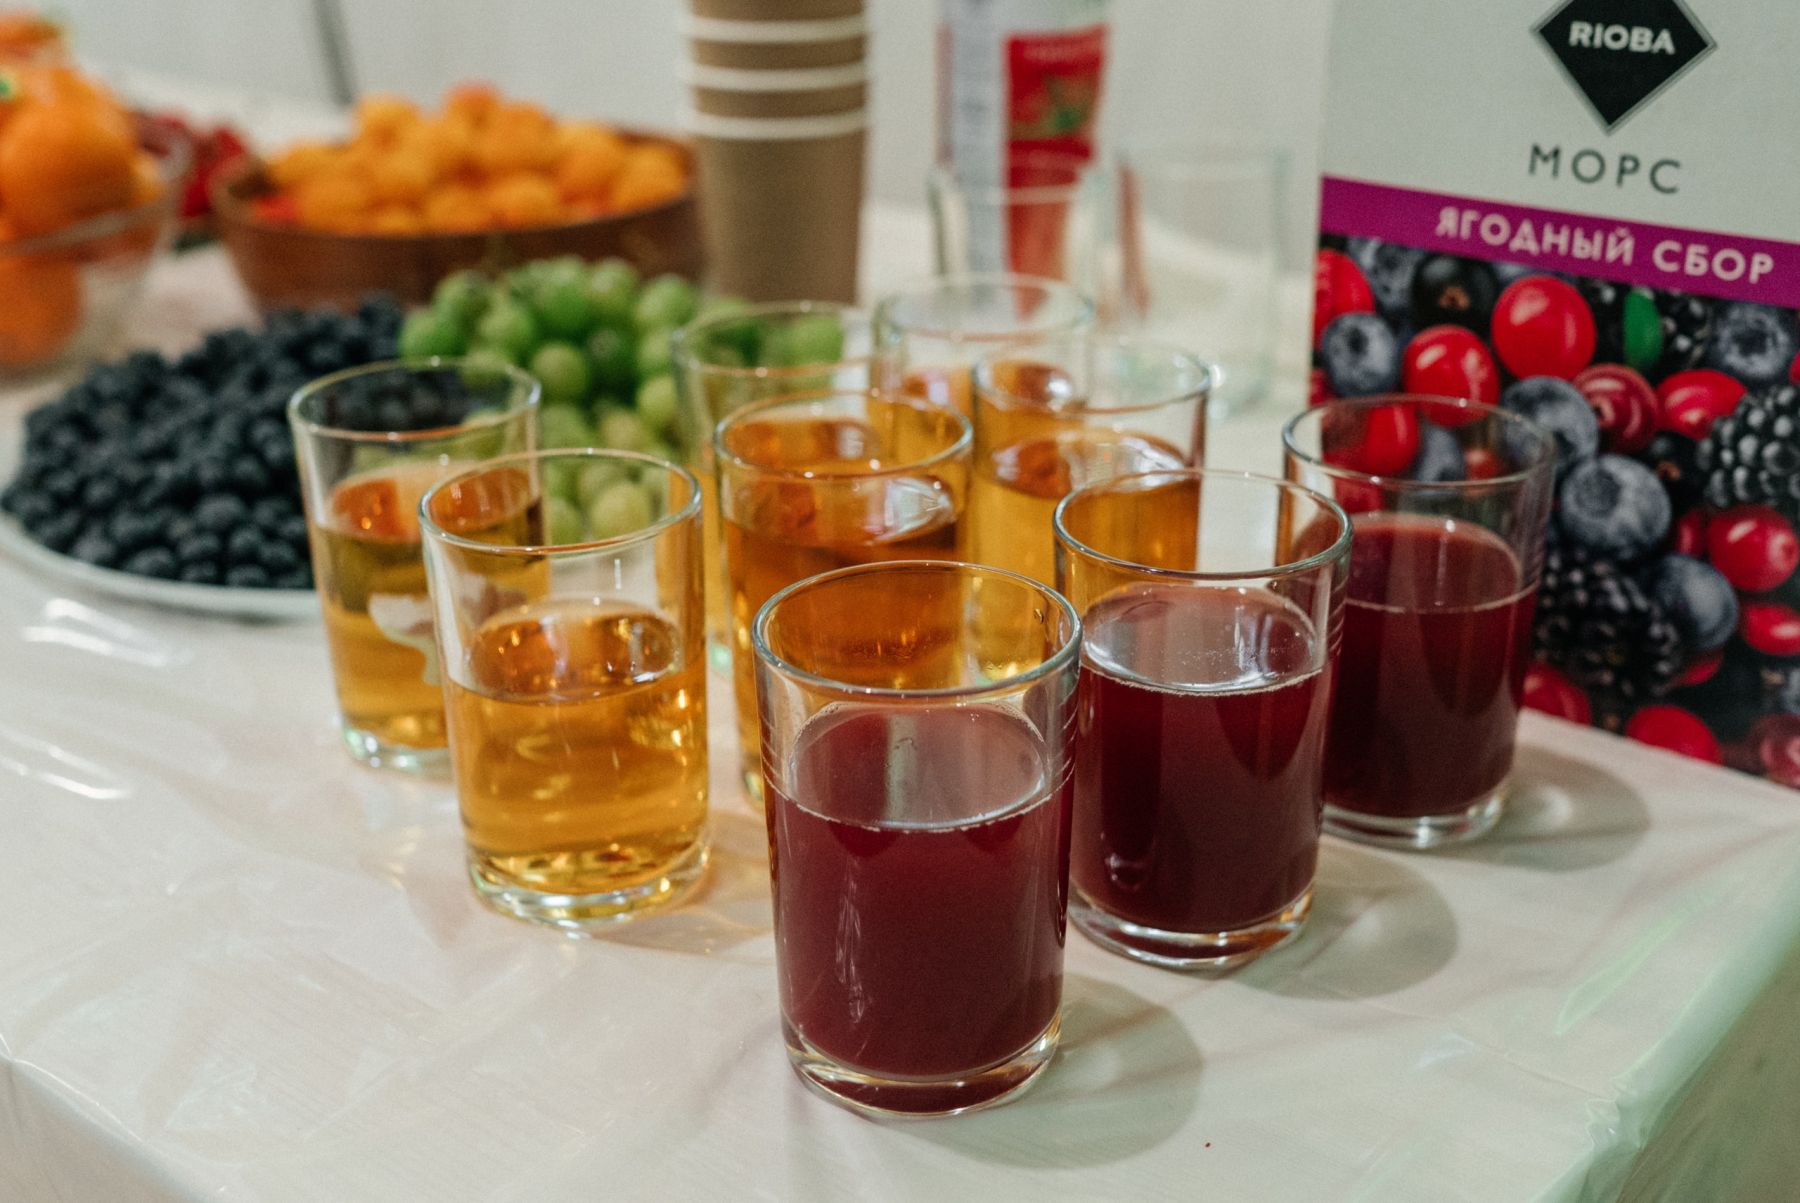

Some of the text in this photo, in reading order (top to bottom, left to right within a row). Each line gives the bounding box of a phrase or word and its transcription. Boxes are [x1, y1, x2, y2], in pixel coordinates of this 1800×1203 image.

[1568, 20, 1676, 55] RIOBA
[1528, 143, 1682, 194] МОРС
[1435, 206, 1775, 285] ЯГОДНЫЙ СБОР
